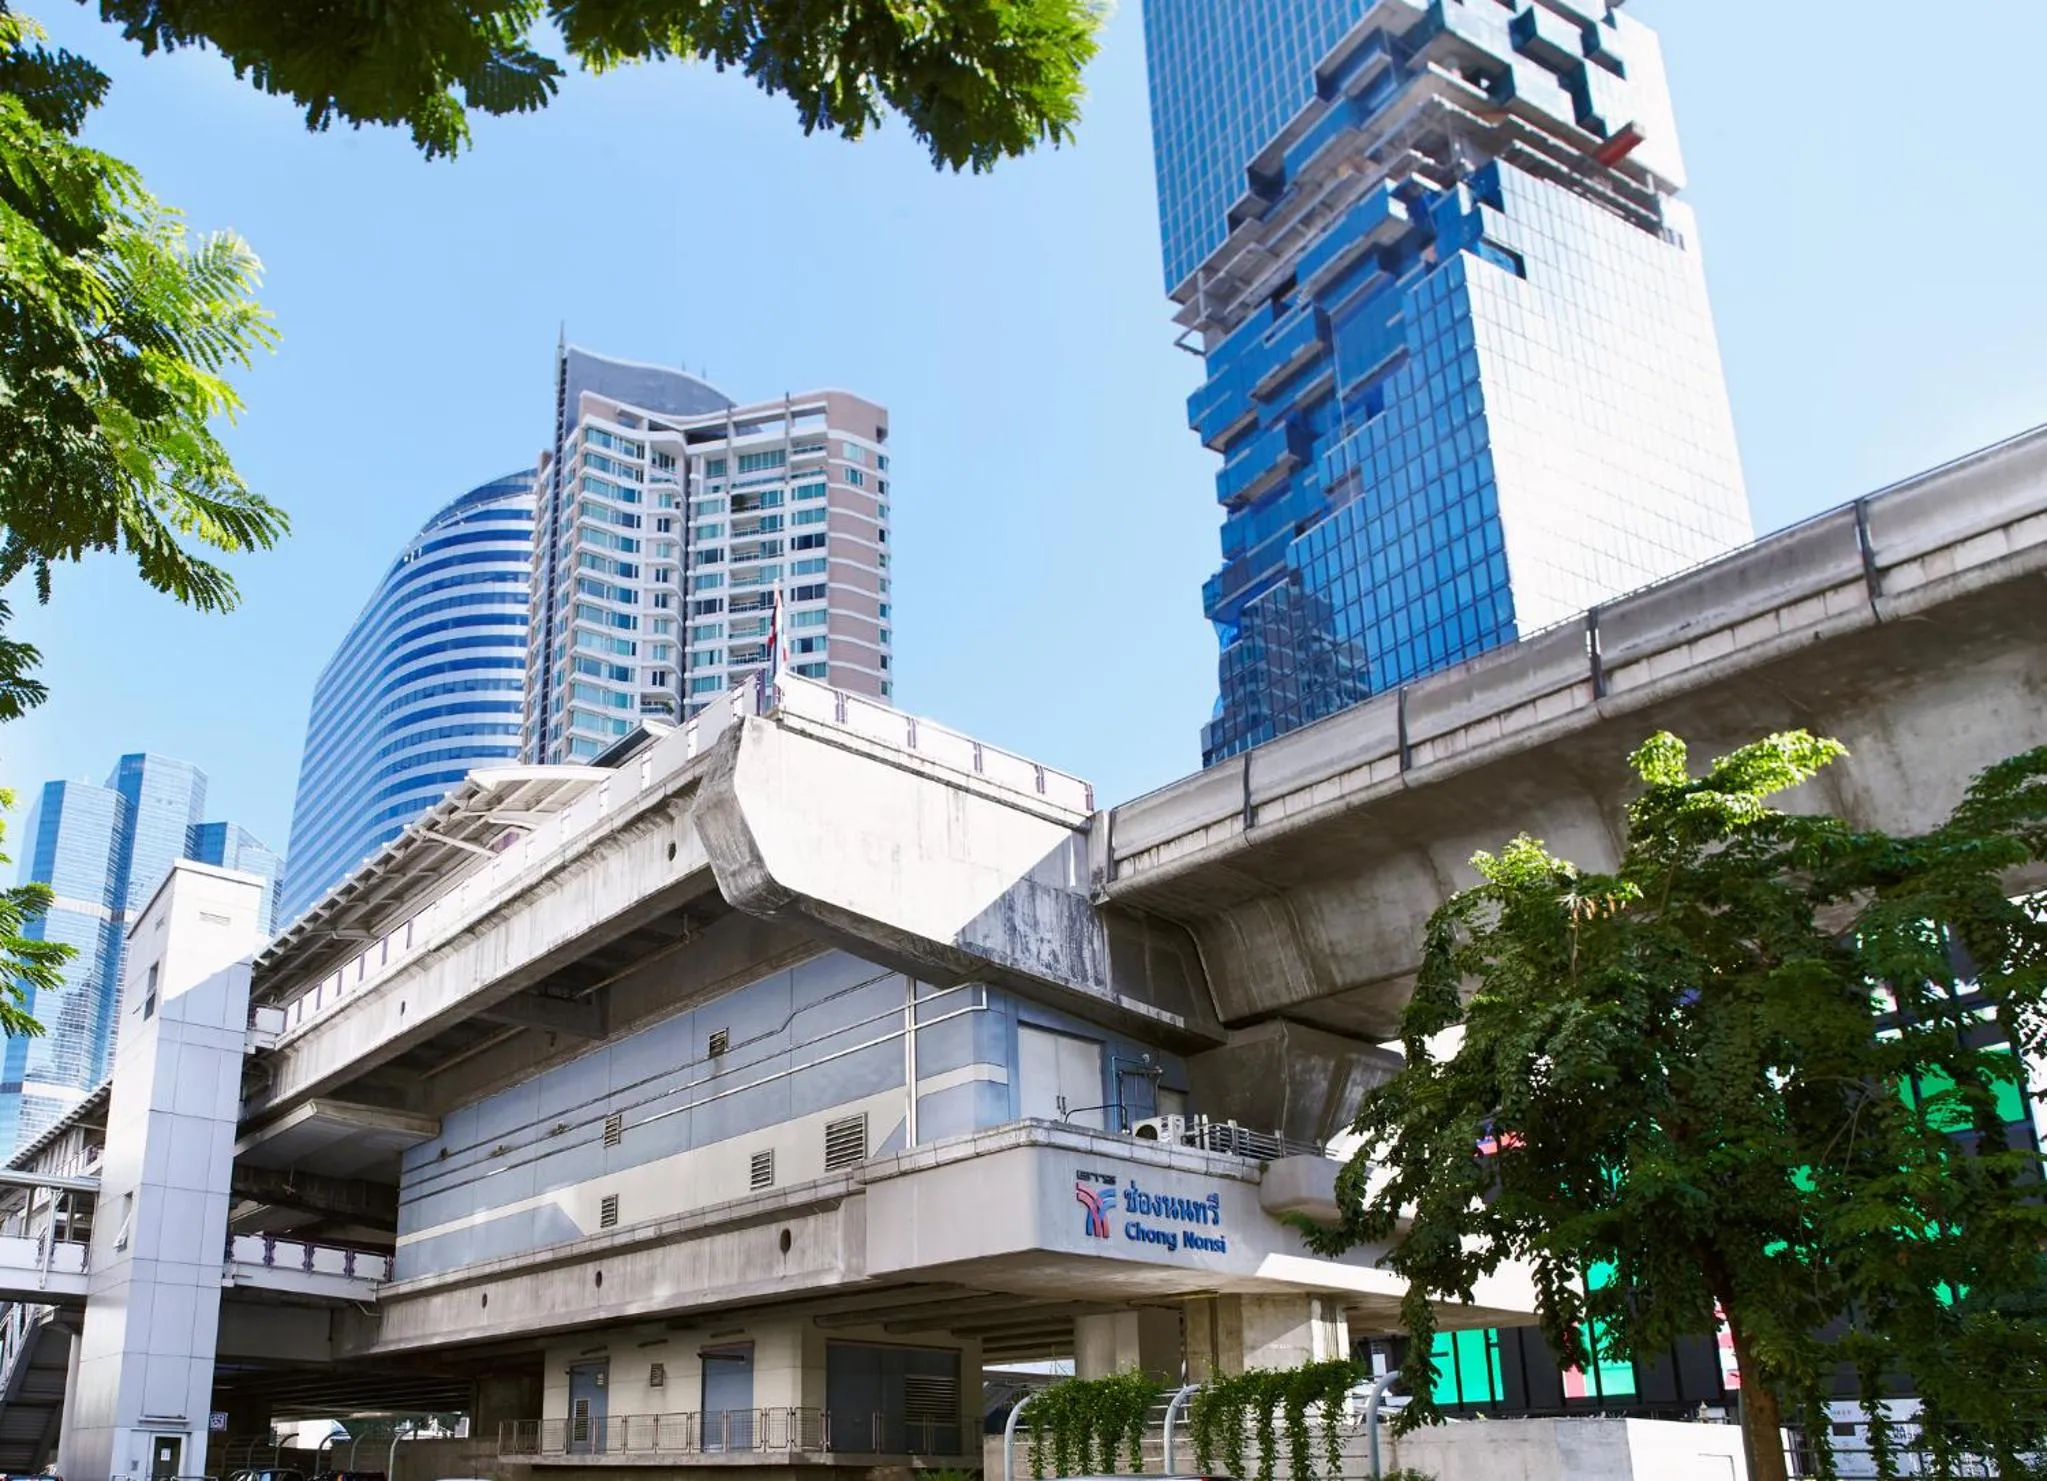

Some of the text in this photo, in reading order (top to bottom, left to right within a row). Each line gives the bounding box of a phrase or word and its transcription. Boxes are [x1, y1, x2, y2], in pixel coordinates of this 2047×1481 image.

[1124, 1180, 1220, 1226] ช่องนนทรี
[1125, 1221, 1227, 1254] Chong Nonsi
